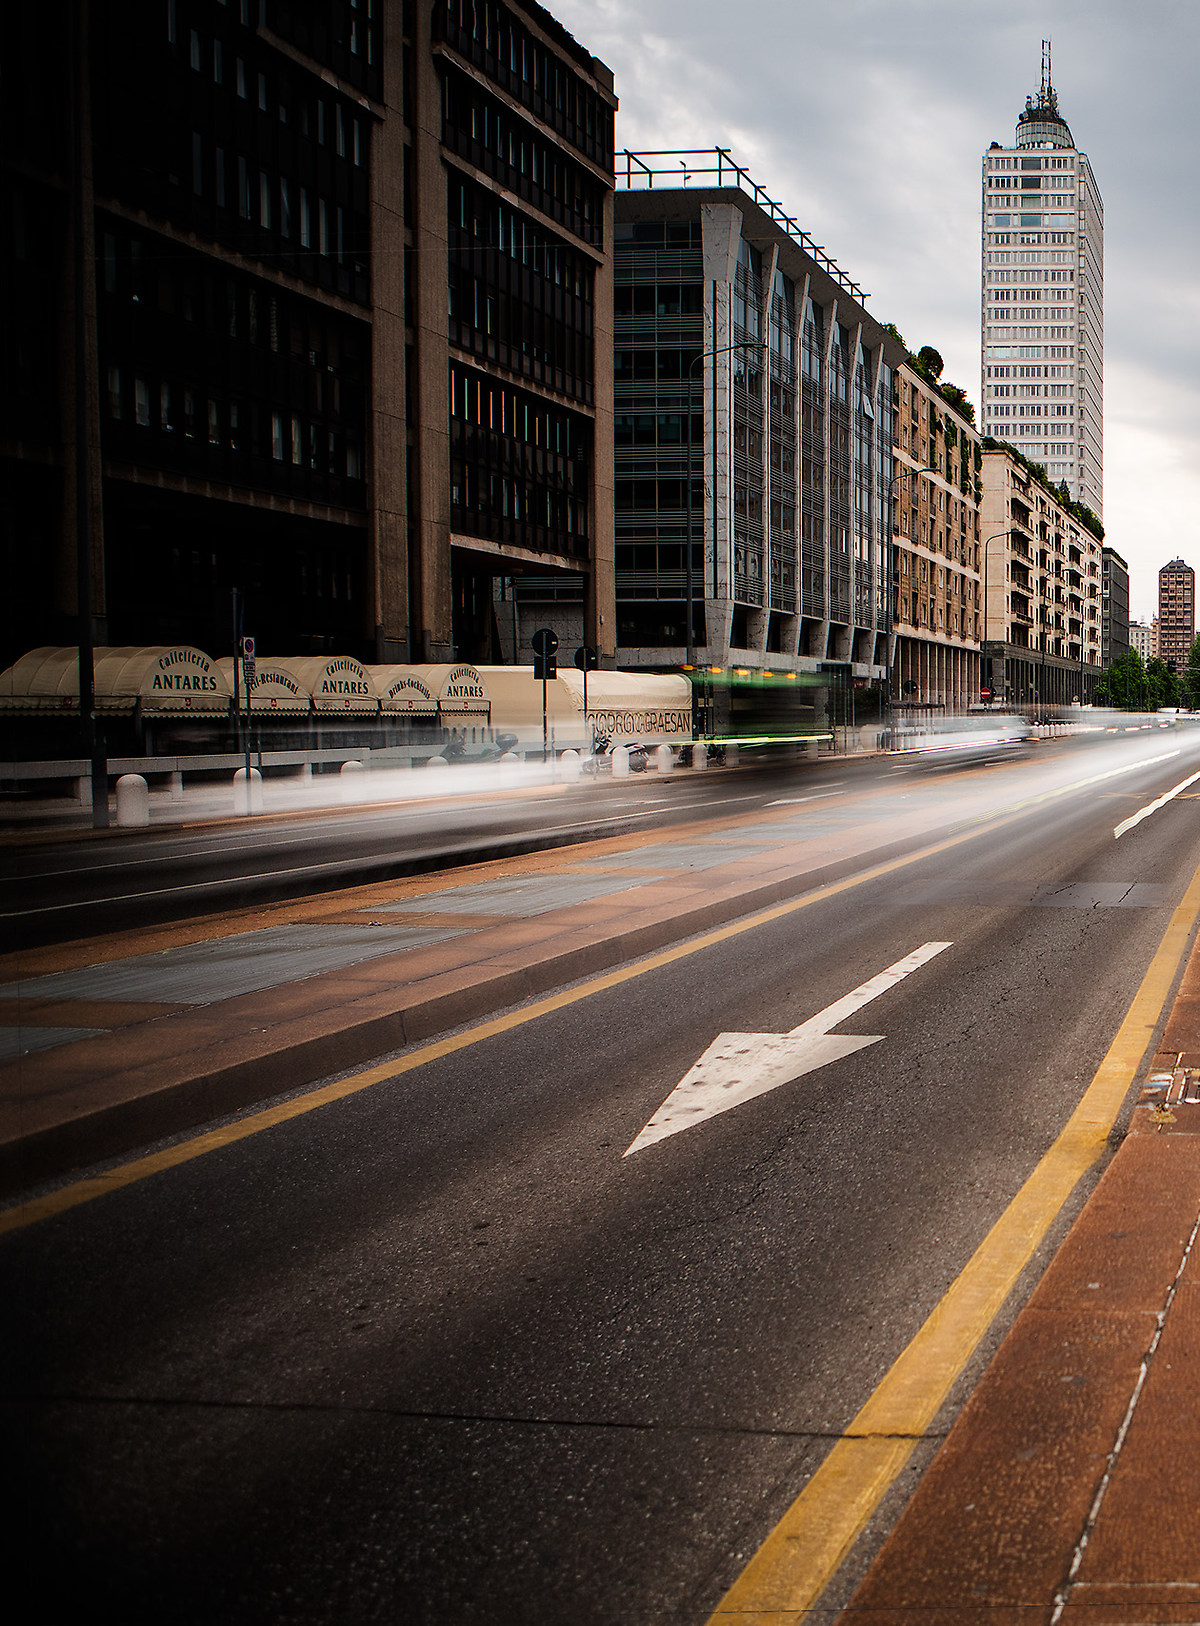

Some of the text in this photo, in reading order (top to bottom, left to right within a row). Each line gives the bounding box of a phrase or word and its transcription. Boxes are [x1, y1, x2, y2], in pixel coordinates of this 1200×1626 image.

[152, 674, 217, 691] ANTARES
[322, 680, 369, 695] ANTARES
[446, 685, 483, 698] ANTARES
